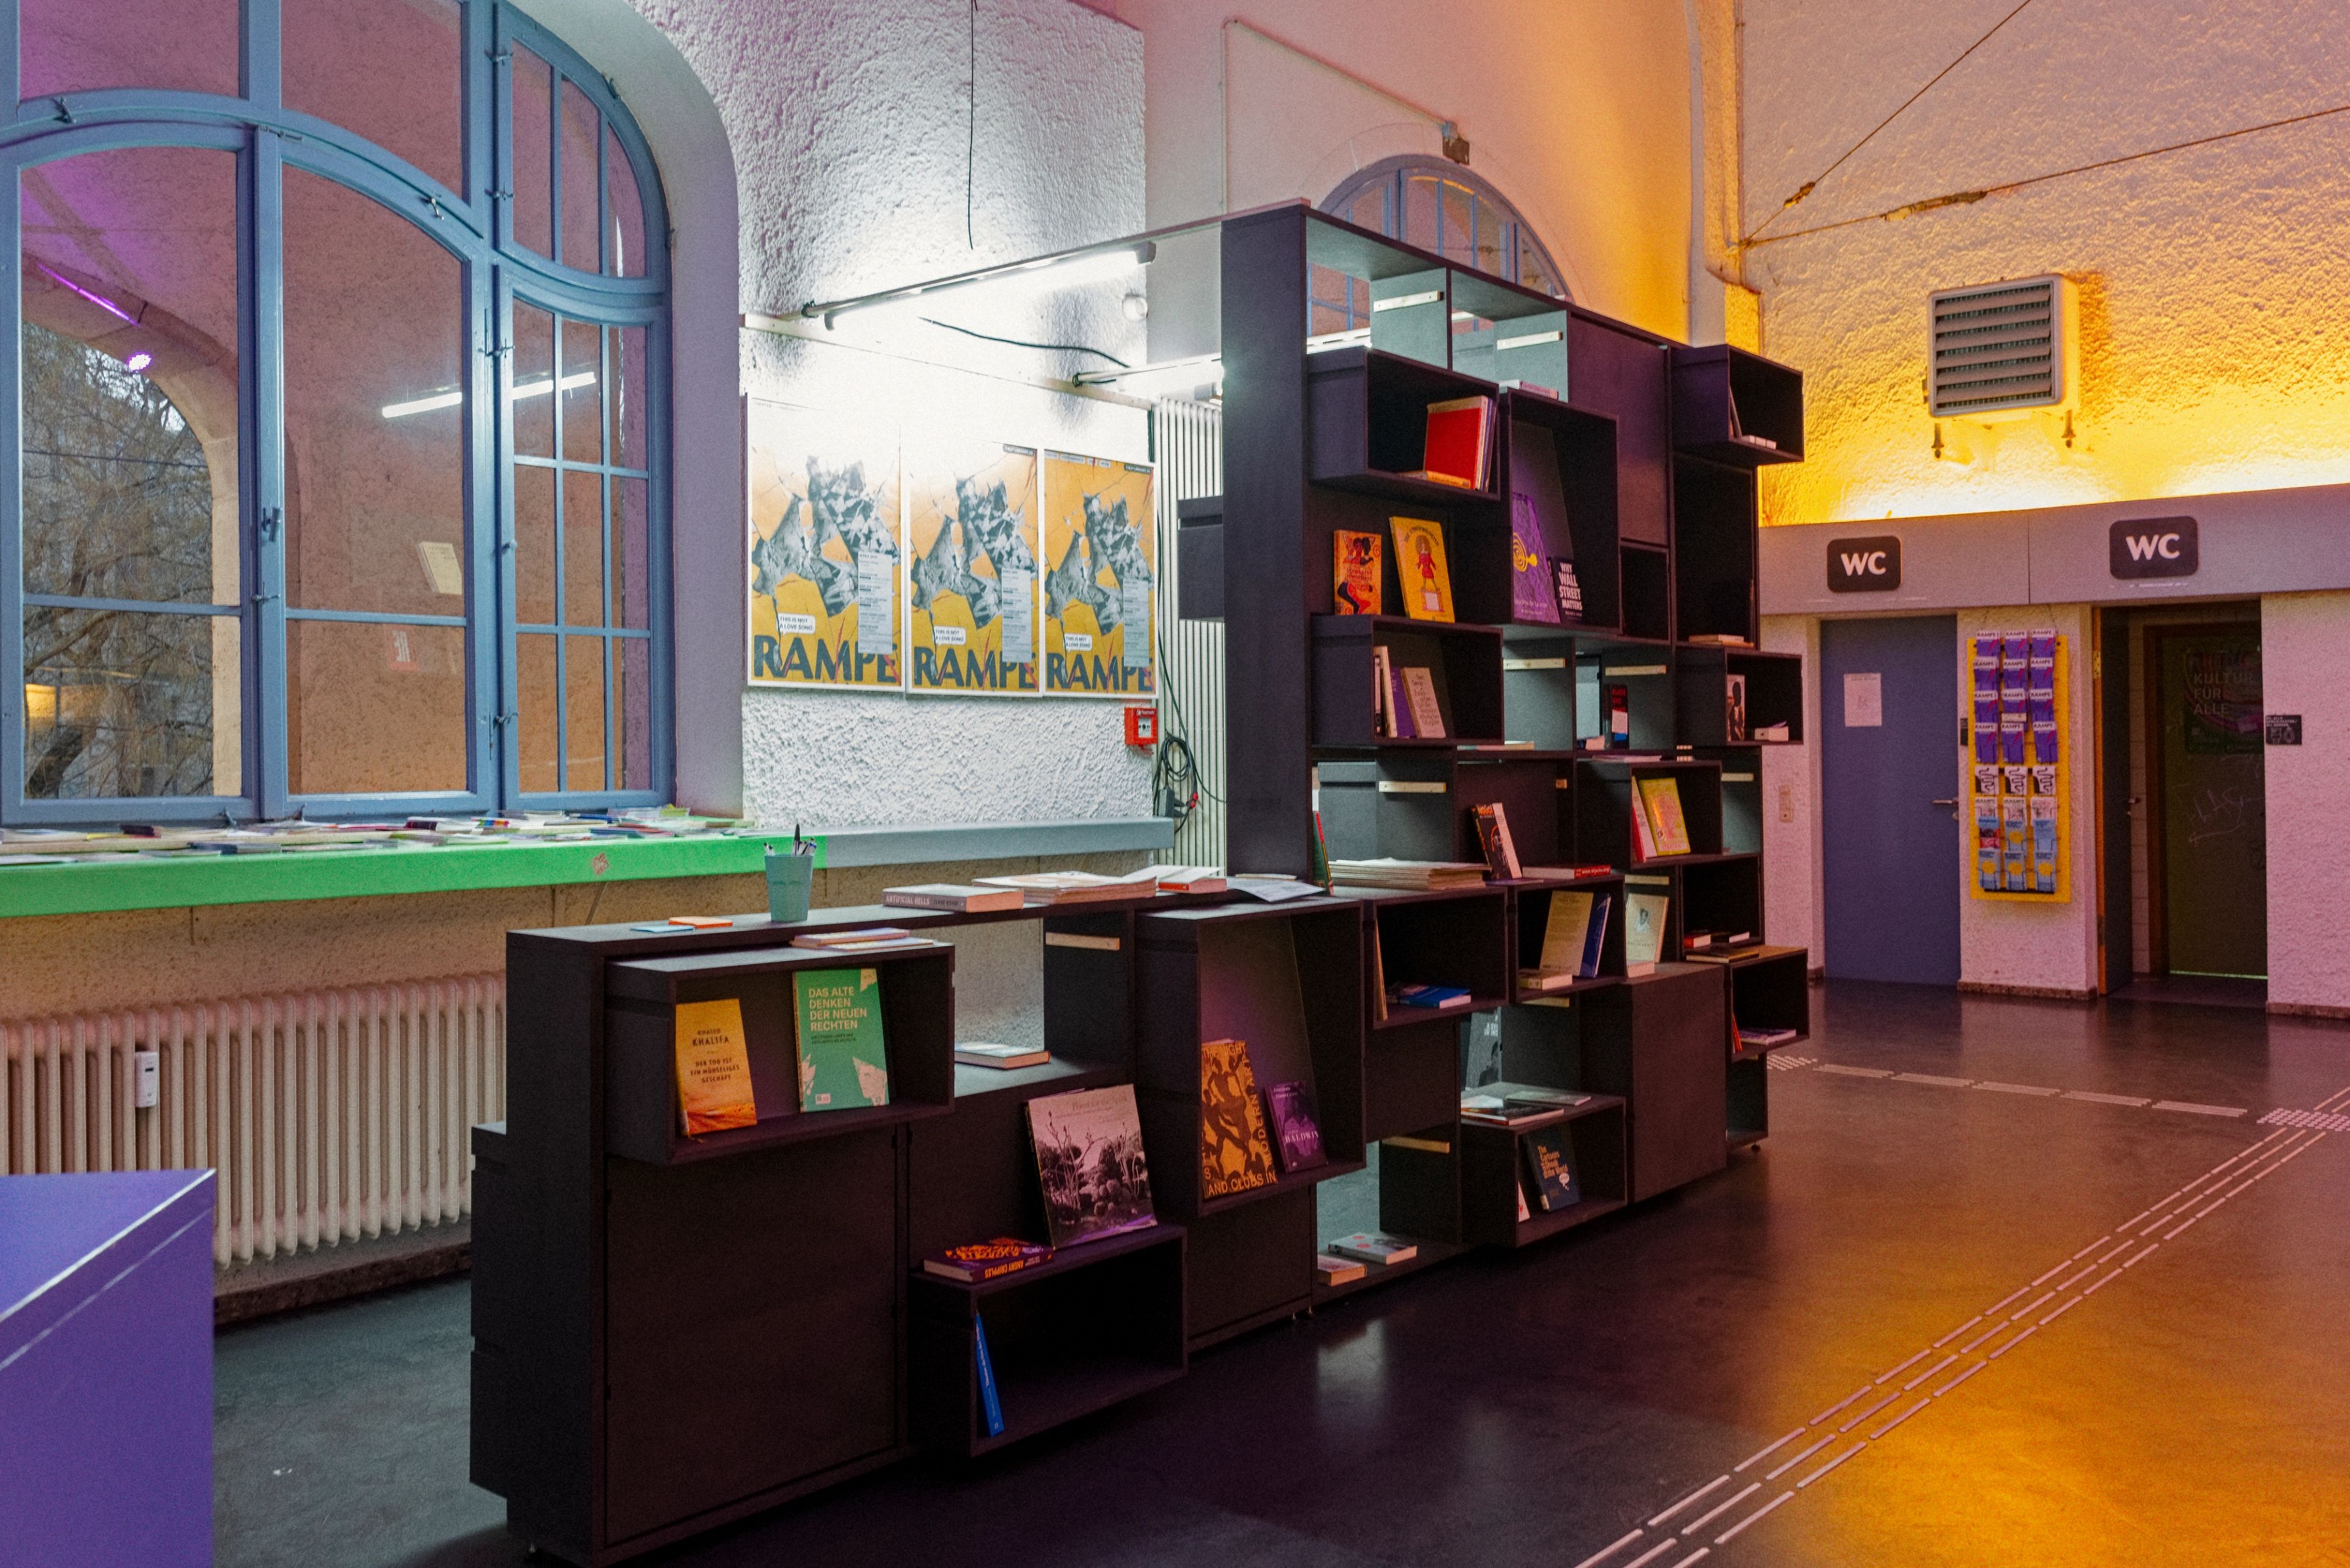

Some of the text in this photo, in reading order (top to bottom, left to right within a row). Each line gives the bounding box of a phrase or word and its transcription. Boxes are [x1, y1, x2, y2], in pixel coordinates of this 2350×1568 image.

[2125, 533, 2180, 561] WC
[1560, 562, 1572, 573] WHY
[1841, 551, 1886, 576] WC
[1558, 571, 1578, 587] WALL
[1559, 585, 1581, 600] STREET
[1562, 598, 1583, 611] MATTERS
[2193, 703, 2228, 715] ALLE
[886, 895, 913, 905] ARTIFICIAL
[914, 897, 930, 906] HELLS
[808, 986, 854, 998] DAS ALTE
[809, 998, 851, 1009] DENKEN
[810, 1007, 867, 1021] DER NEUEN
[811, 1020, 857, 1031] RECHTEN
[692, 1035, 729, 1047] KHALIFA
[703, 1064, 740, 1074] MÜHSELIGES
[1286, 1130, 1318, 1143] BALDWIN
[1208, 1171, 1276, 1196] AND CLUBS IN
[985, 1266, 1008, 1279] CRIPPLES
